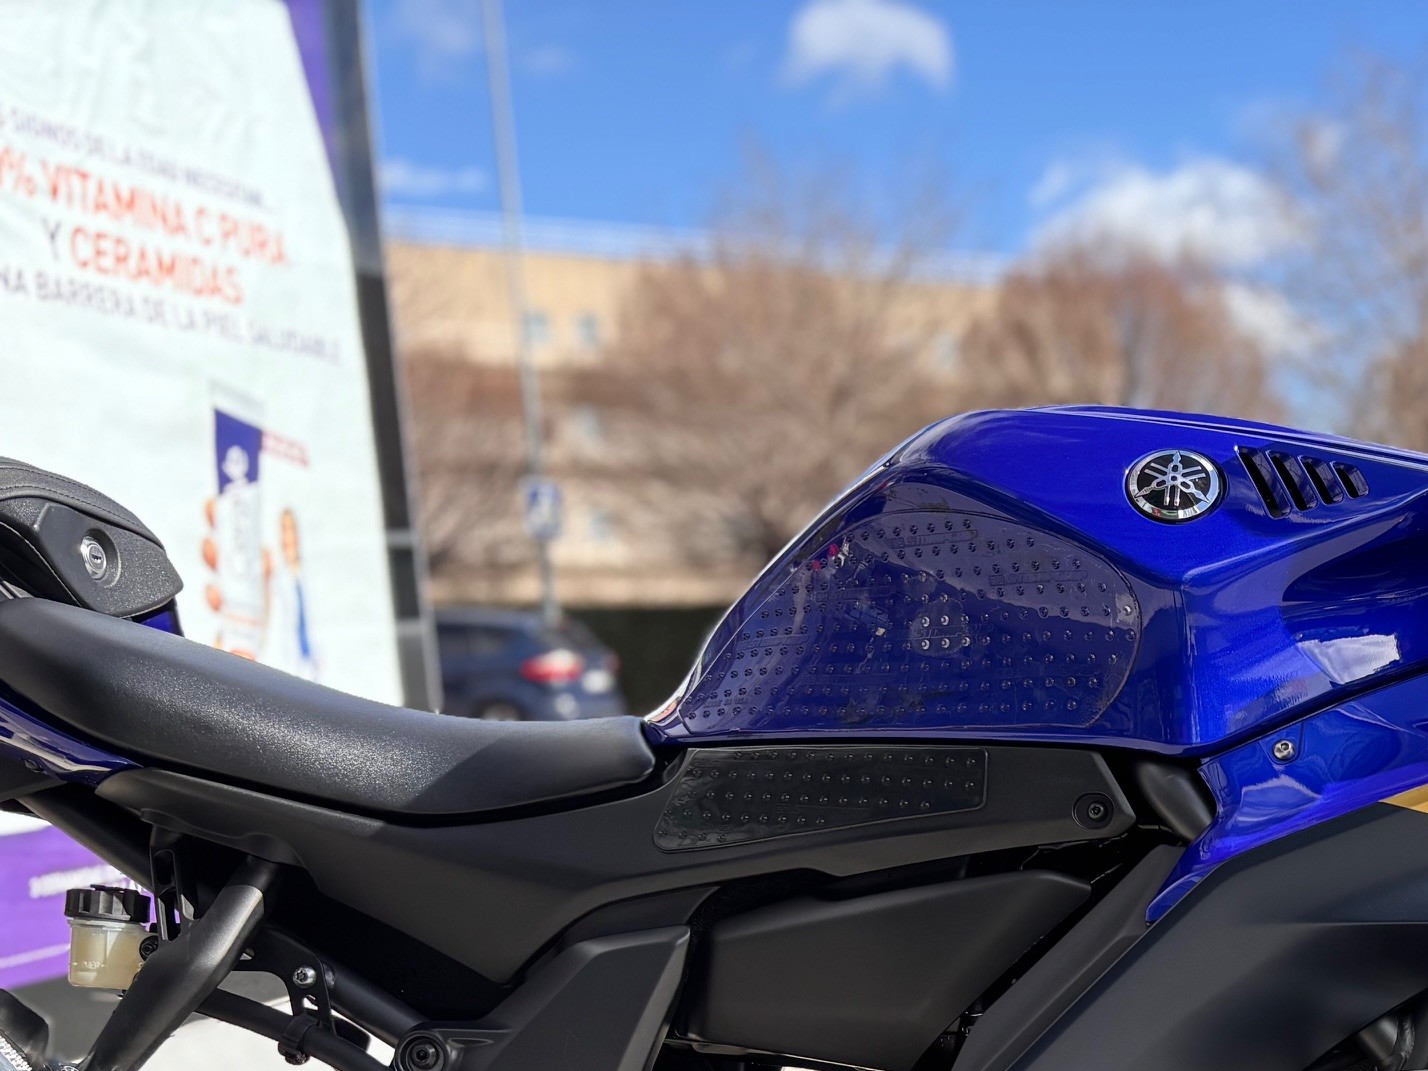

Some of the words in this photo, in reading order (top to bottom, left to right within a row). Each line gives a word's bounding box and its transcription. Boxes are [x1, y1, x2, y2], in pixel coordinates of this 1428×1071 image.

[40, 158, 188, 236] VITAMINA
[42, 217, 61, 262] Y
[70, 225, 244, 306] CERAMIDAS
